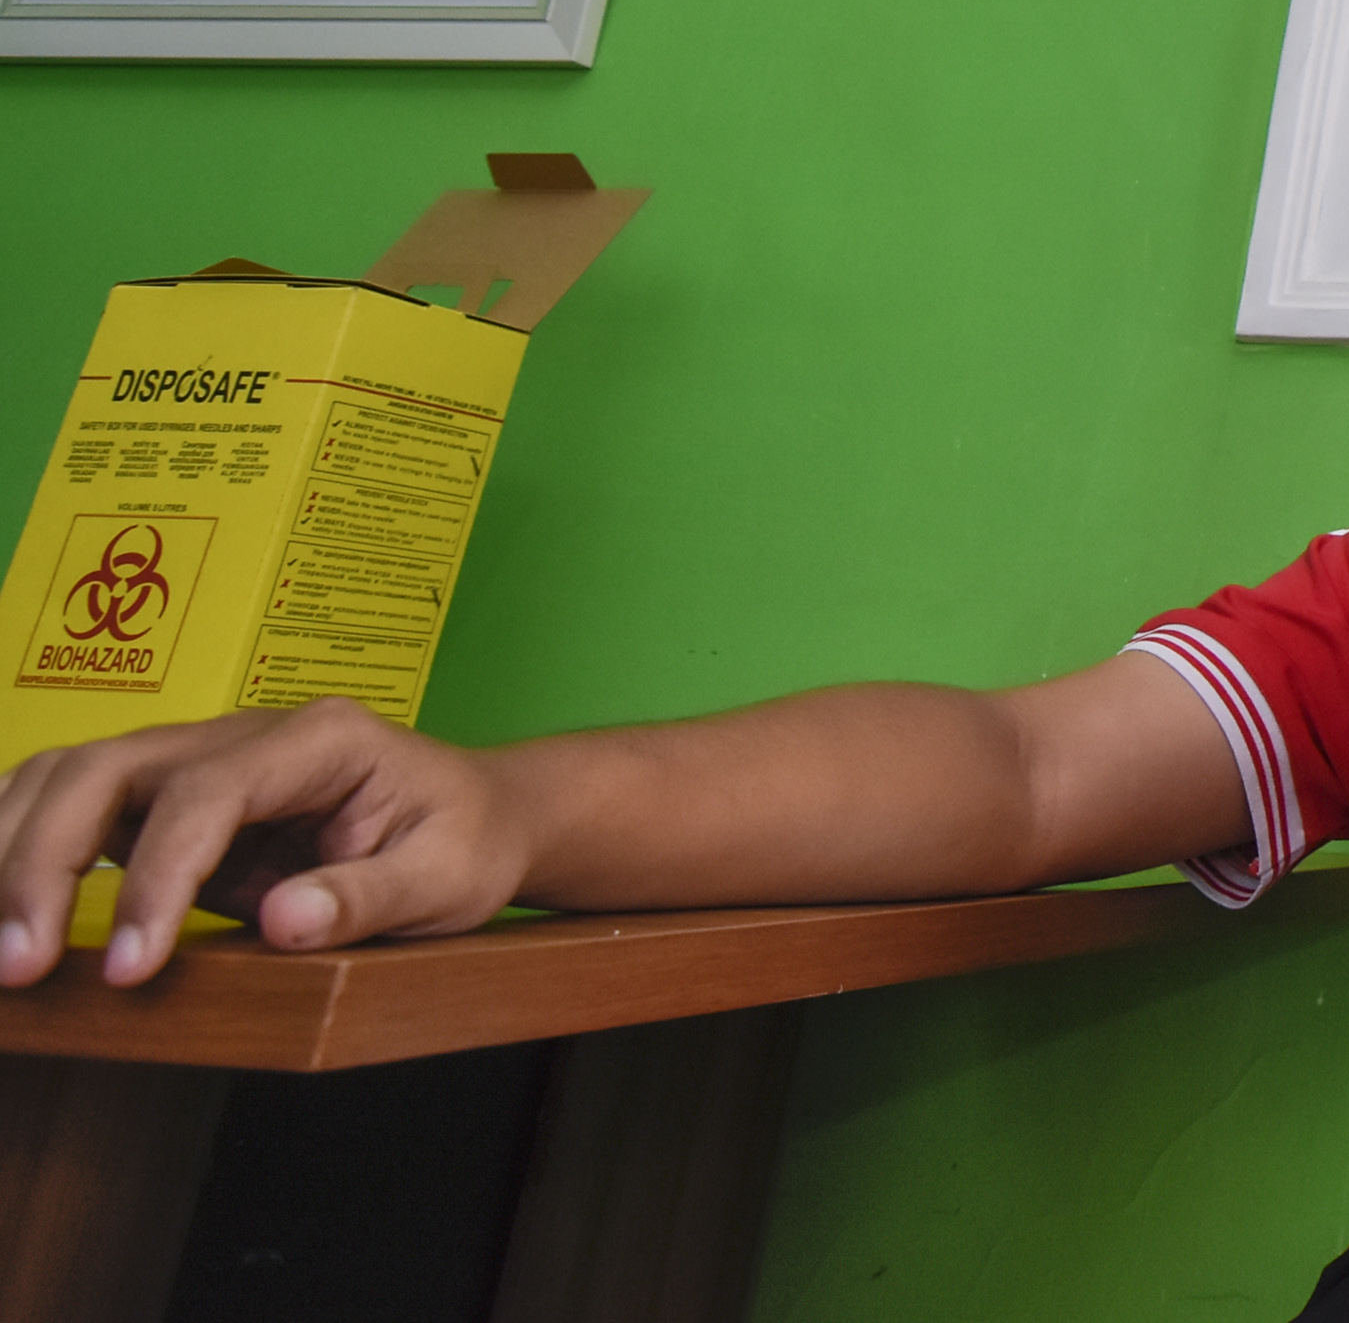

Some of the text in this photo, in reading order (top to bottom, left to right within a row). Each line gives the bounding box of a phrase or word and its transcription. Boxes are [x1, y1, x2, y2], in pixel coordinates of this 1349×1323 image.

[112, 369, 270, 405] DISPOSAFE
[78, 420, 107, 430] SAFETY
[105, 421, 123, 430] BOX
[137, 421, 159, 431] USED
[196, 423, 233, 432] NEEDLES
[231, 423, 250, 433] AND
[249, 424, 283, 433] SHARPS
[37, 645, 154, 673] BIOHAZARD
